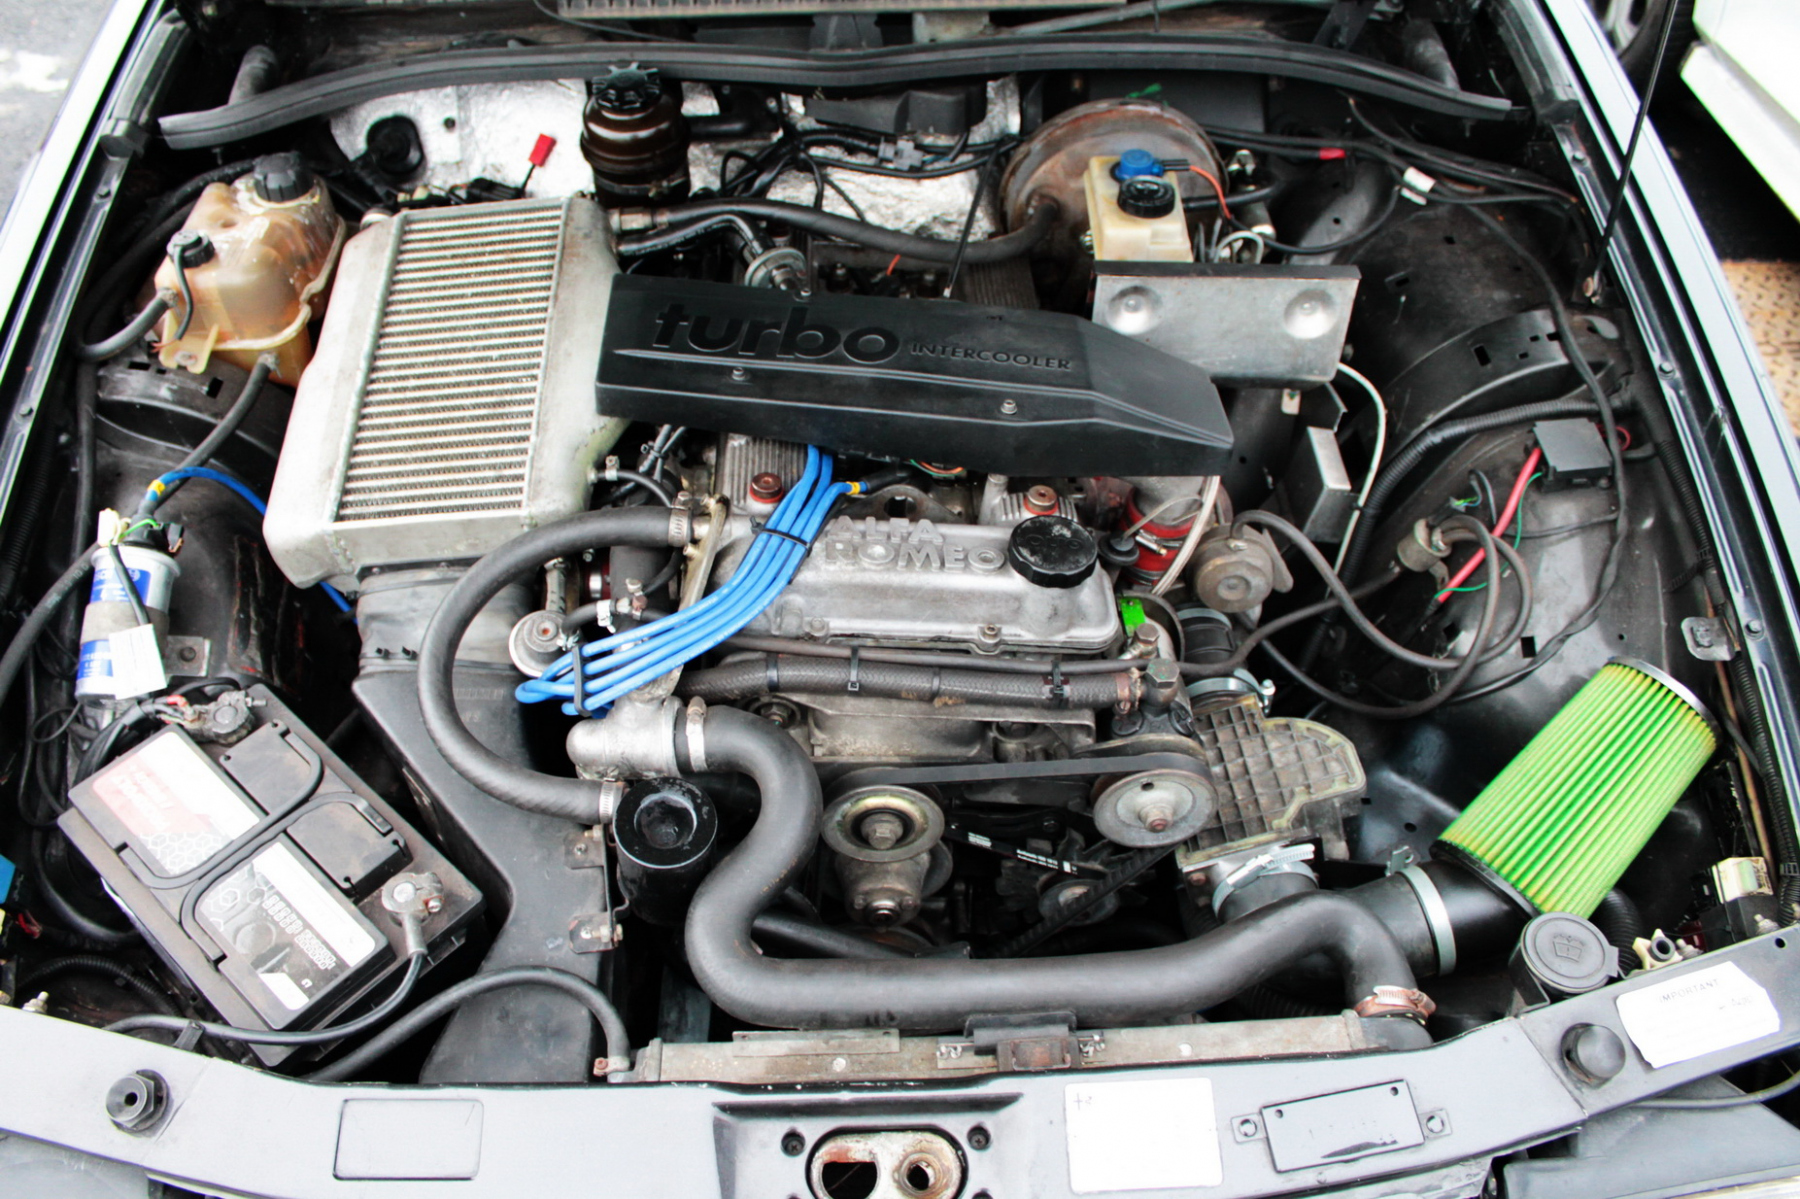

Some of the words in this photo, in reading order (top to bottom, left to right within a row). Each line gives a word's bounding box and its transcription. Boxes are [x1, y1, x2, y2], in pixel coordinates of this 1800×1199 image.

[653, 303, 900, 364] turbo
[911, 342, 1072, 371] INTERCOOLER
[827, 515, 944, 544] ALFA
[825, 540, 1005, 574] ROMEO
[1659, 978, 1719, 1003] IMPORTANT
